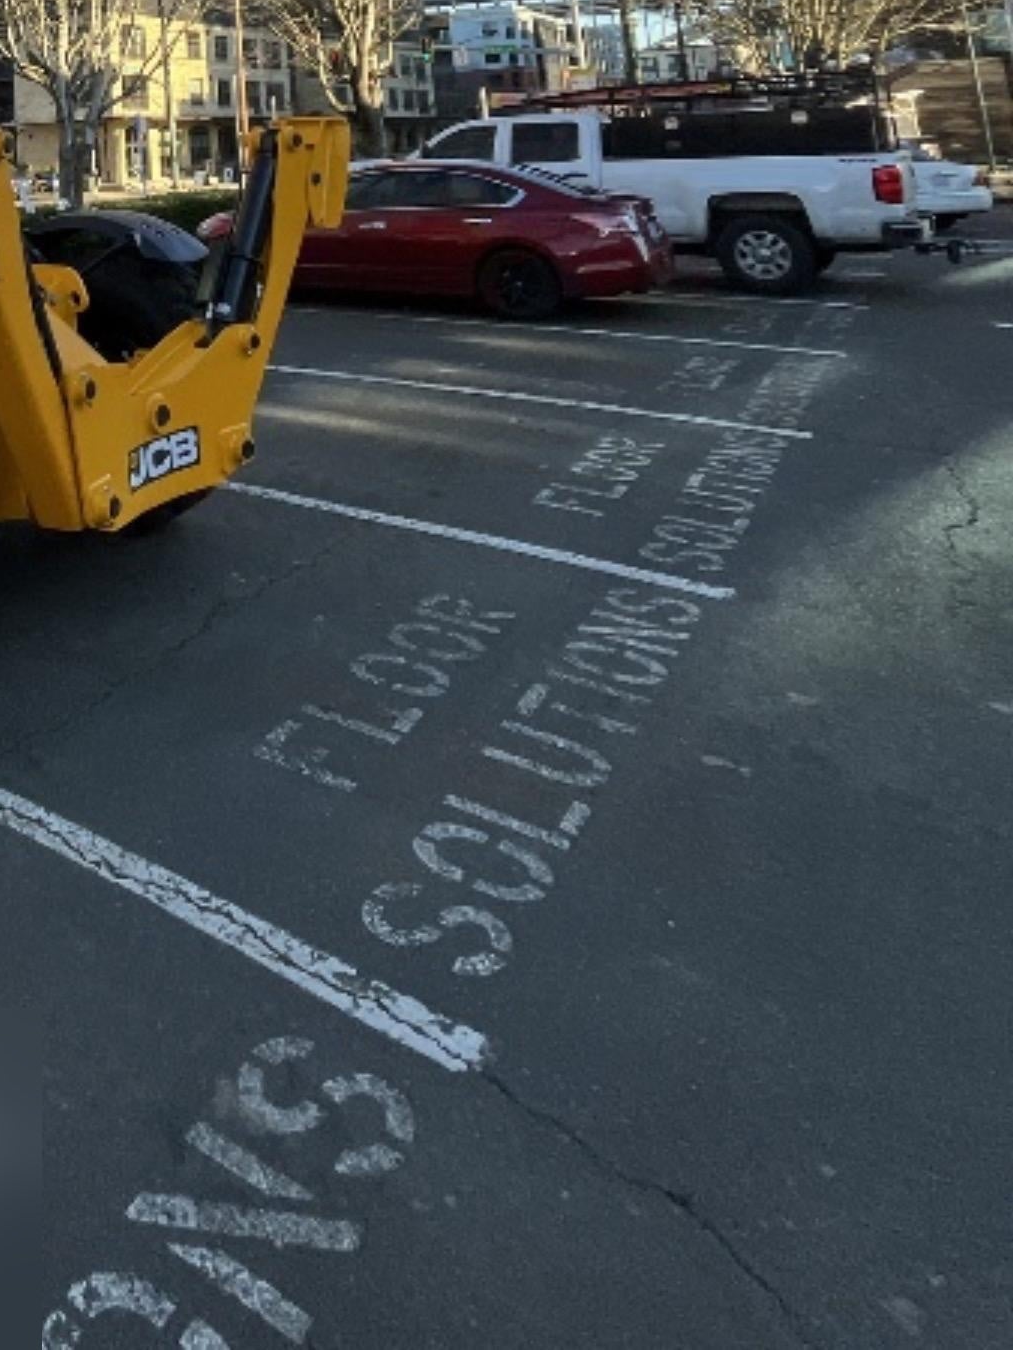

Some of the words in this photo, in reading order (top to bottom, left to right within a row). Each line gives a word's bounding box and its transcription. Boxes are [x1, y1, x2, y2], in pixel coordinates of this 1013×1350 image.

[130, 428, 199, 488] JCB
[254, 592, 516, 792] FLOOR
[360, 587, 701, 977] SOLUTIONS
